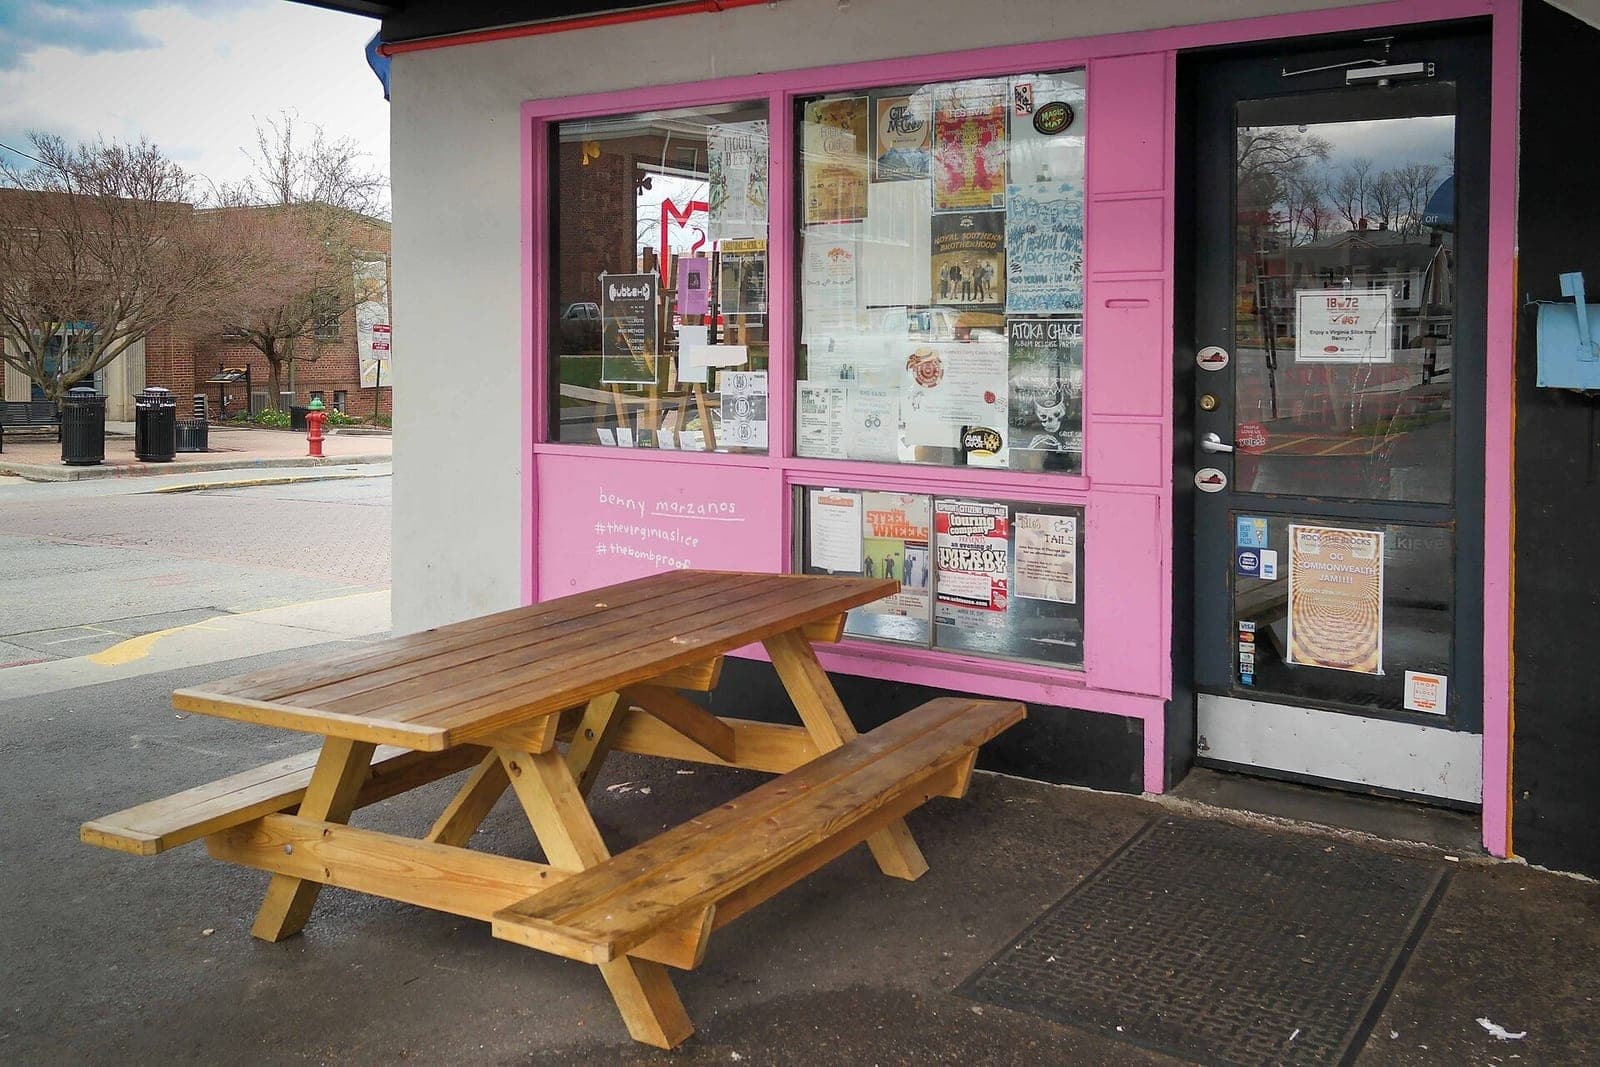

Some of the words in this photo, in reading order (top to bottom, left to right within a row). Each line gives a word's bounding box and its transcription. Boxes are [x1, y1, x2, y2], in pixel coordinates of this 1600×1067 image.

[1041, 108, 1064, 122] MAGIC
[934, 232, 959, 245] ROYAL
[962, 231, 1004, 242] SOUTHERN
[940, 241, 997, 251] BROTHERHOOD
[1341, 316, 1360, 326] #67
[1012, 323, 1044, 340] ATOKA
[1047, 322, 1081, 340] CHASE
[1239, 438, 1257, 448] yelp
[599, 486, 646, 518] benny
[655, 499, 737, 515] marzanos
[950, 514, 995, 530] touring
[594, 521, 700, 548] #thevirginiaslice
[872, 523, 928, 540] WHEELS
[950, 527, 990, 536] company
[1044, 534, 1074, 546] TAILS
[938, 547, 1007, 564] IMPROV
[1329, 552, 1345, 561] OG
[939, 559, 1007, 573] COMEDY
[1297, 560, 1377, 576] COMMONWEALTH
